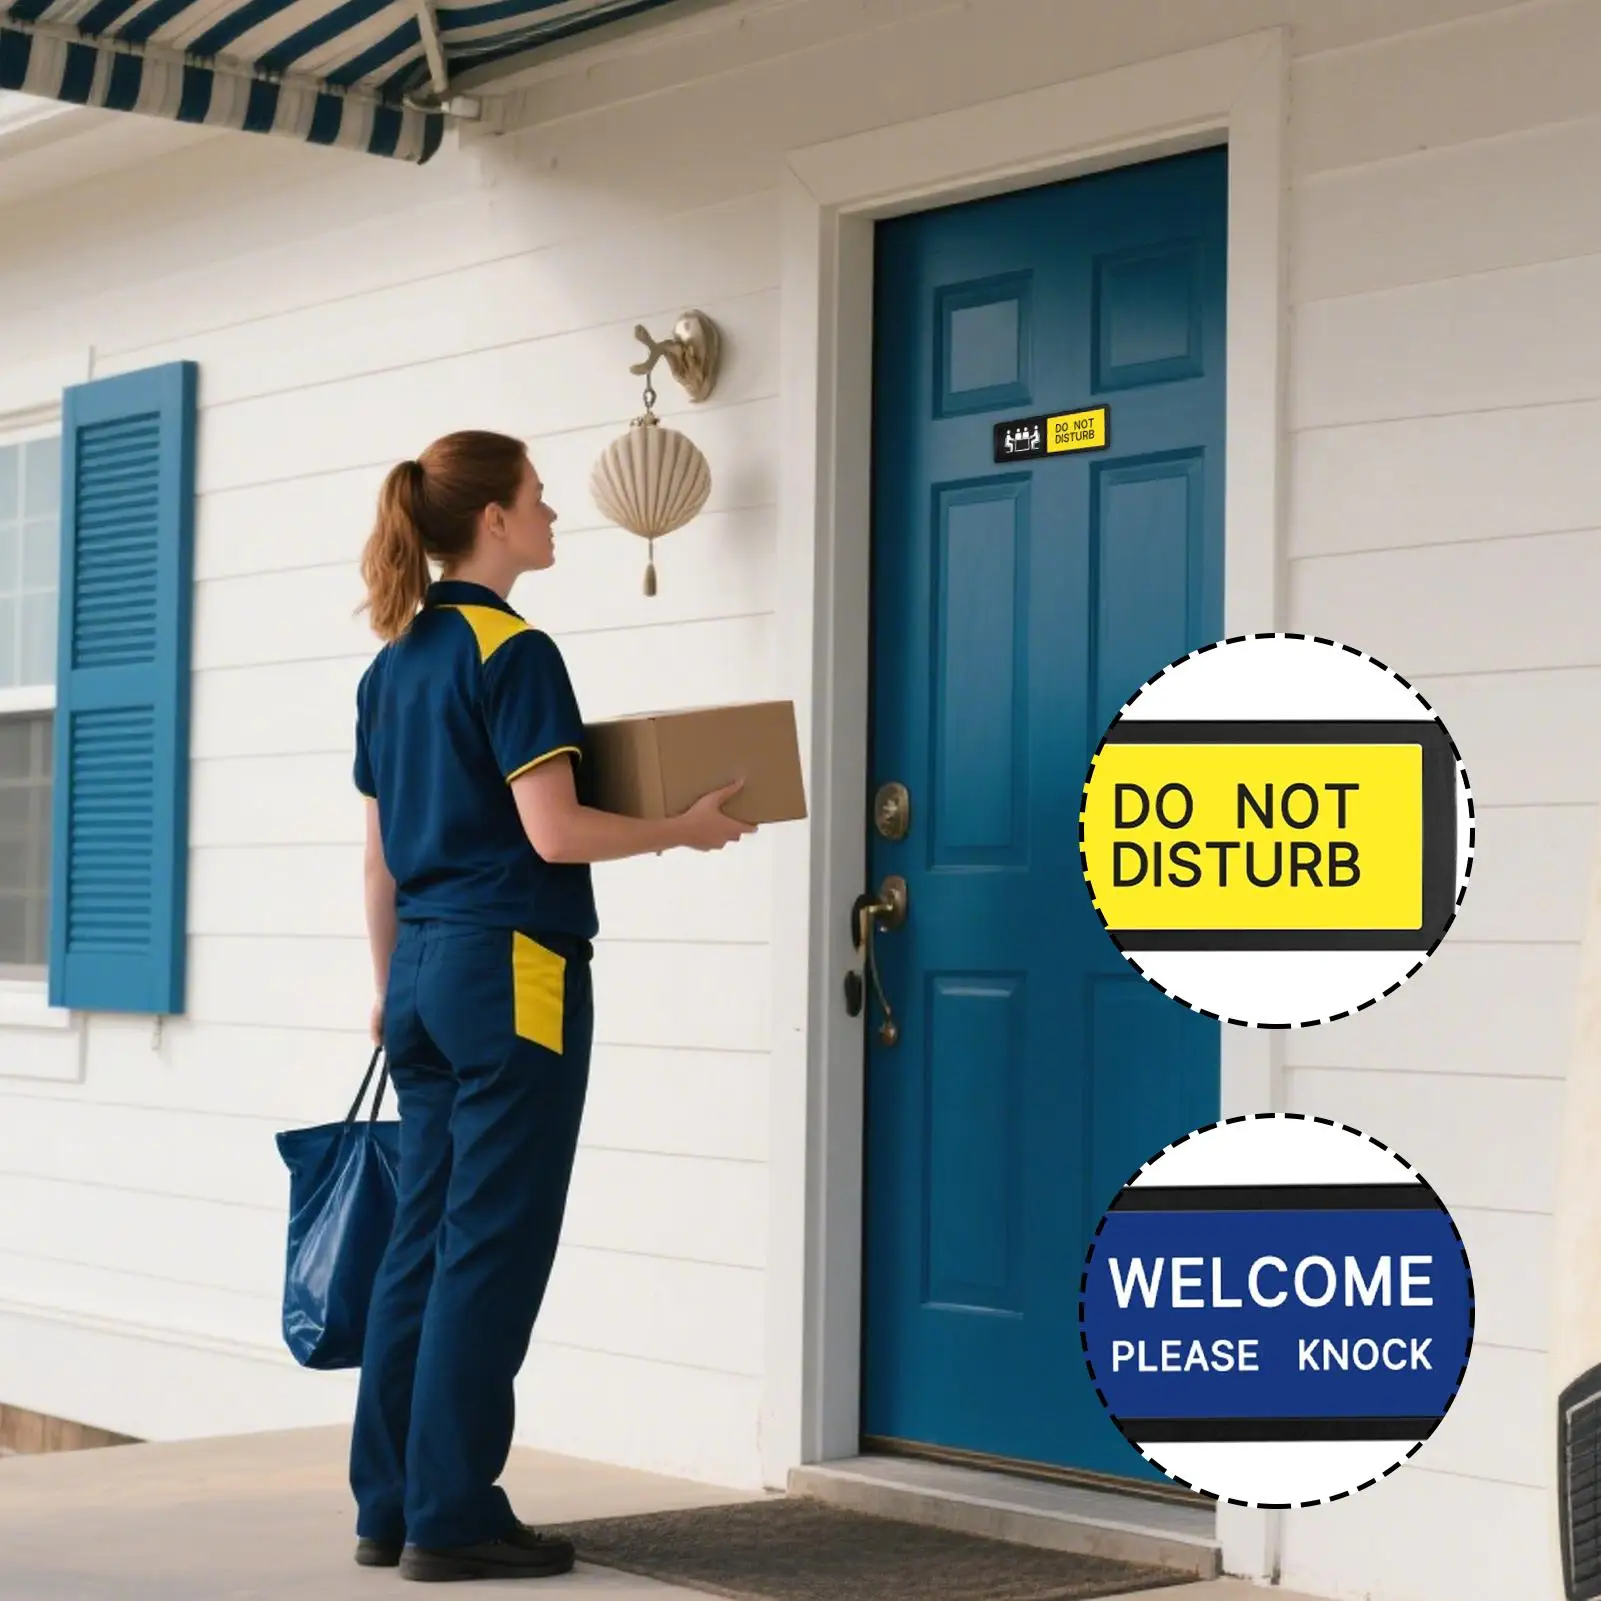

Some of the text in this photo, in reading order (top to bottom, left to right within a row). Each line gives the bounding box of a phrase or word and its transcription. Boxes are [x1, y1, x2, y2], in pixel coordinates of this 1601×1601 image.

[1055, 418, 1095, 433] DO NOT
[1055, 429, 1095, 444] DISTURB
